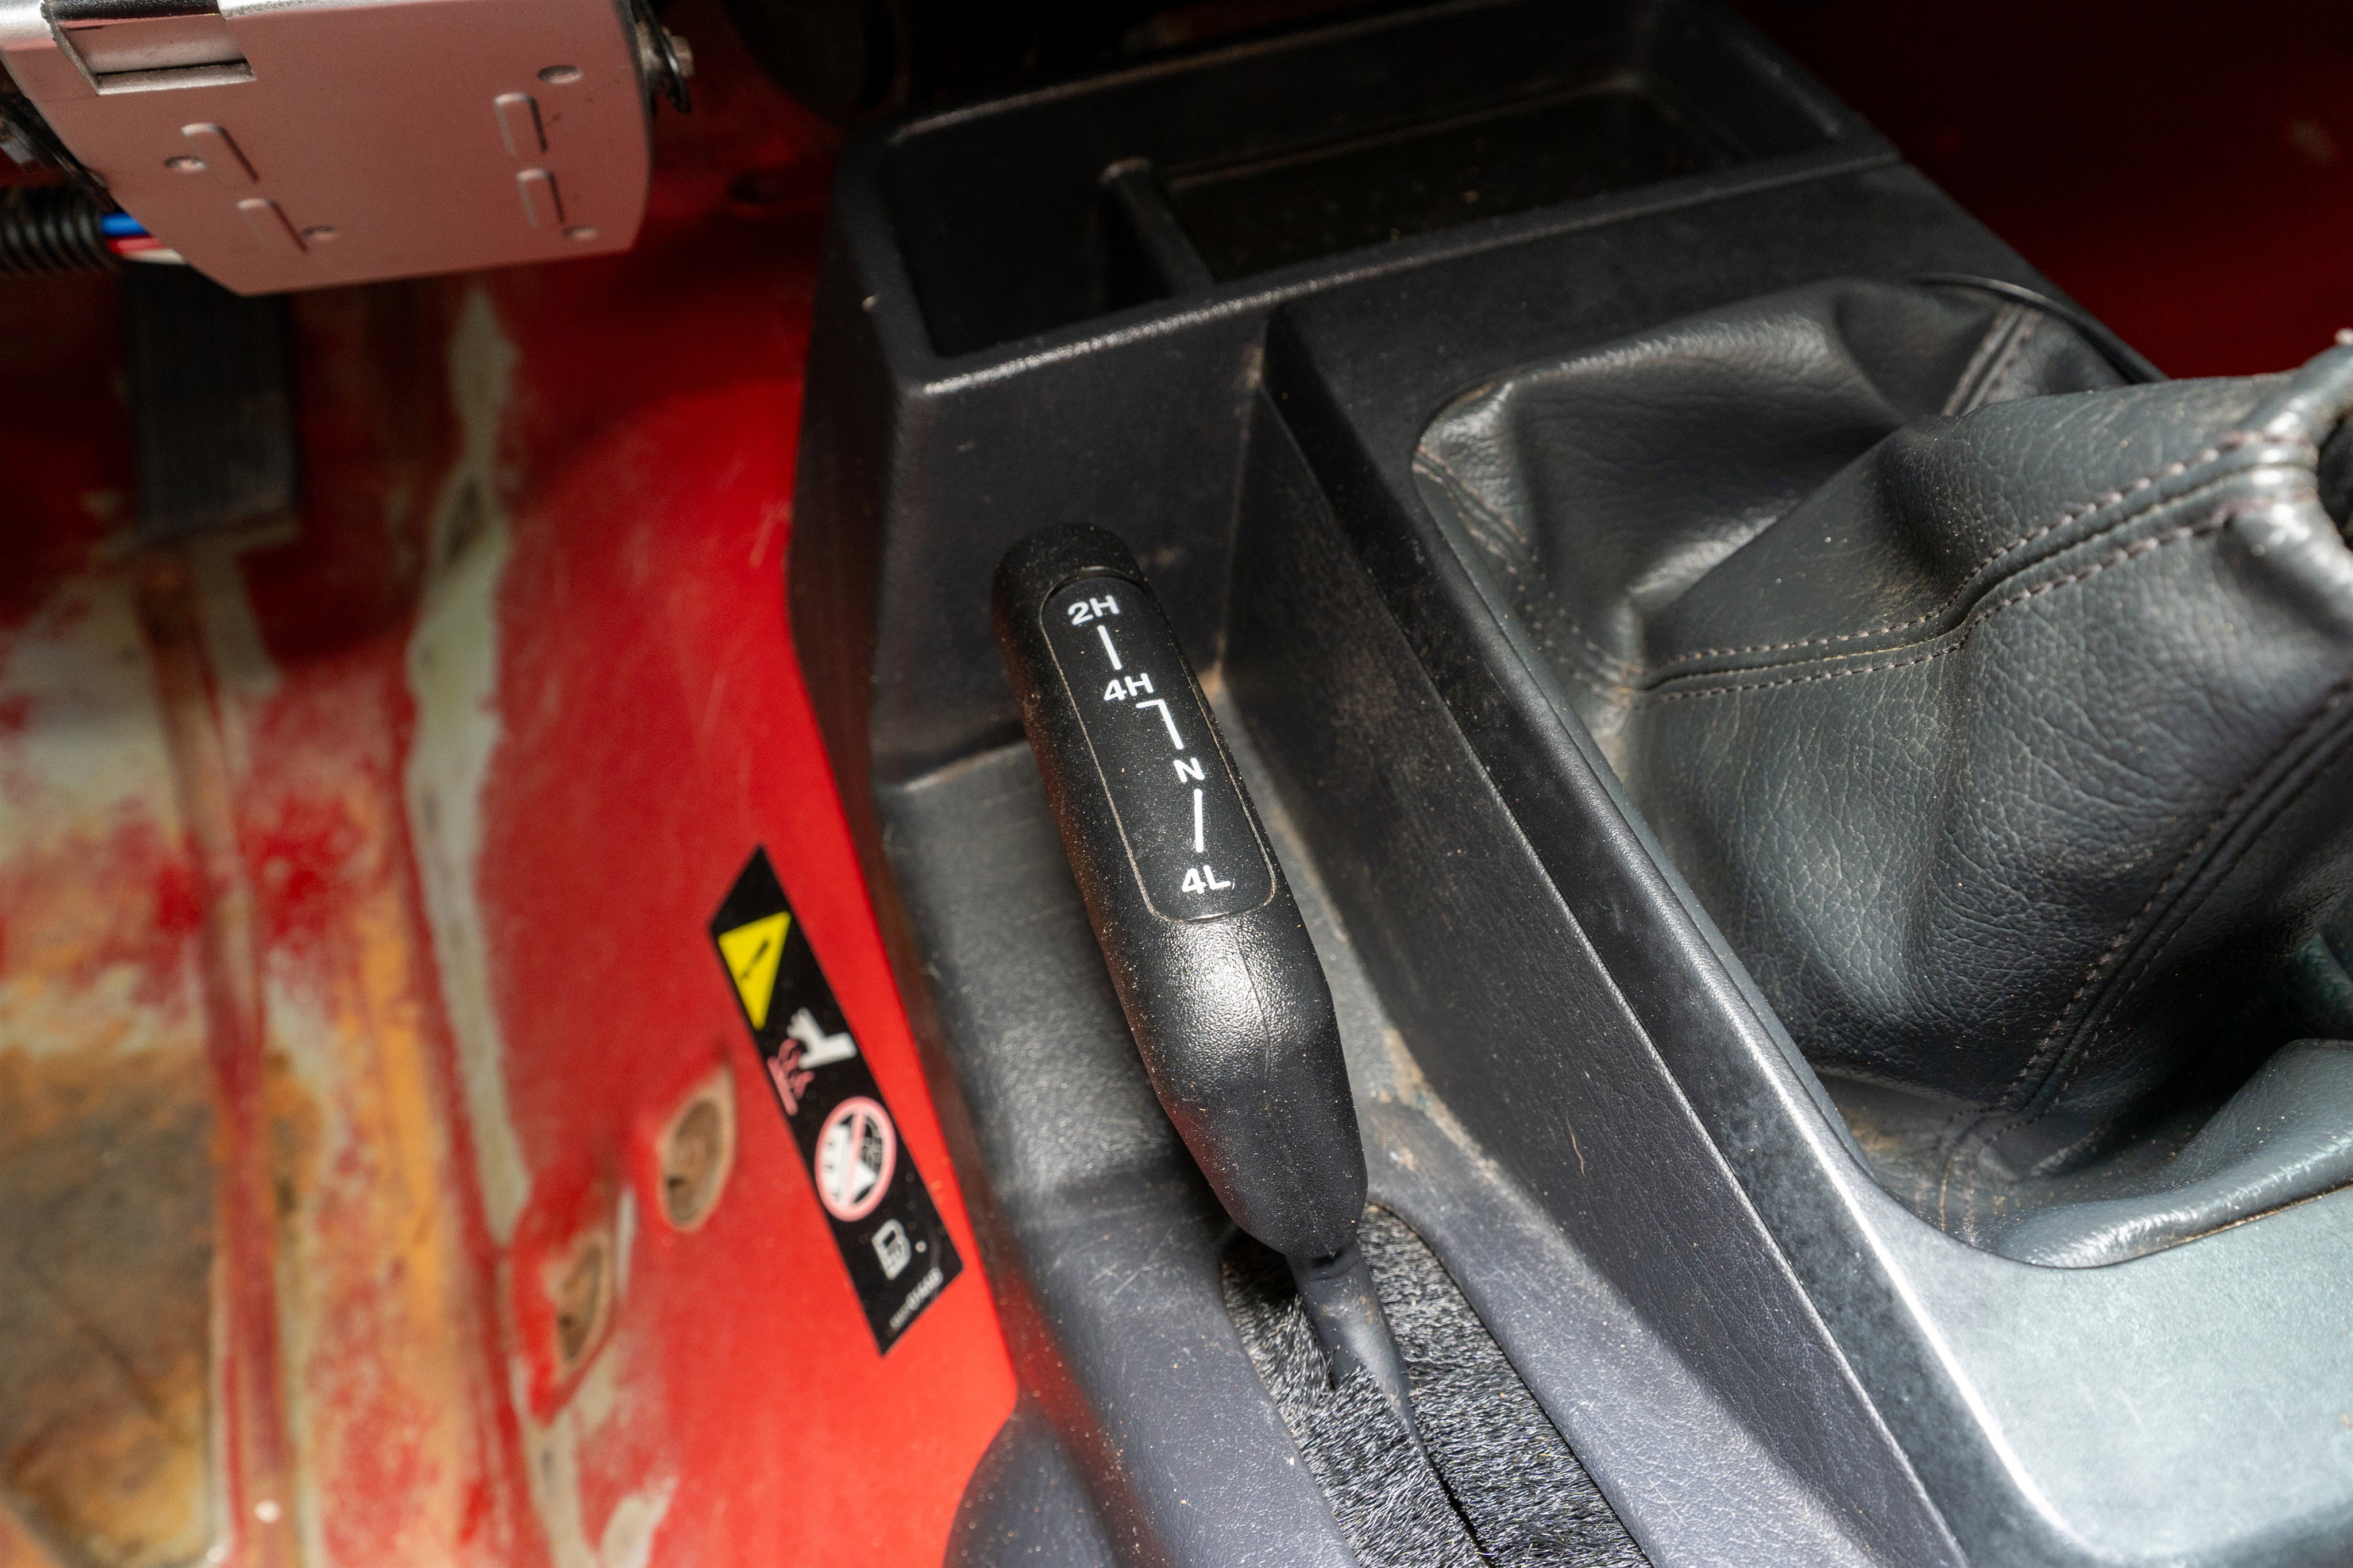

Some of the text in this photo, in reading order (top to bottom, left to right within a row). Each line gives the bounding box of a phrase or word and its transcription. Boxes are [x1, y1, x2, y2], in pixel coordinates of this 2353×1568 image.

[1068, 595, 1120, 625] 2H
[1104, 673, 1154, 701] 4H
[1173, 758, 1205, 783] N
[1182, 865, 1231, 894] 4L
